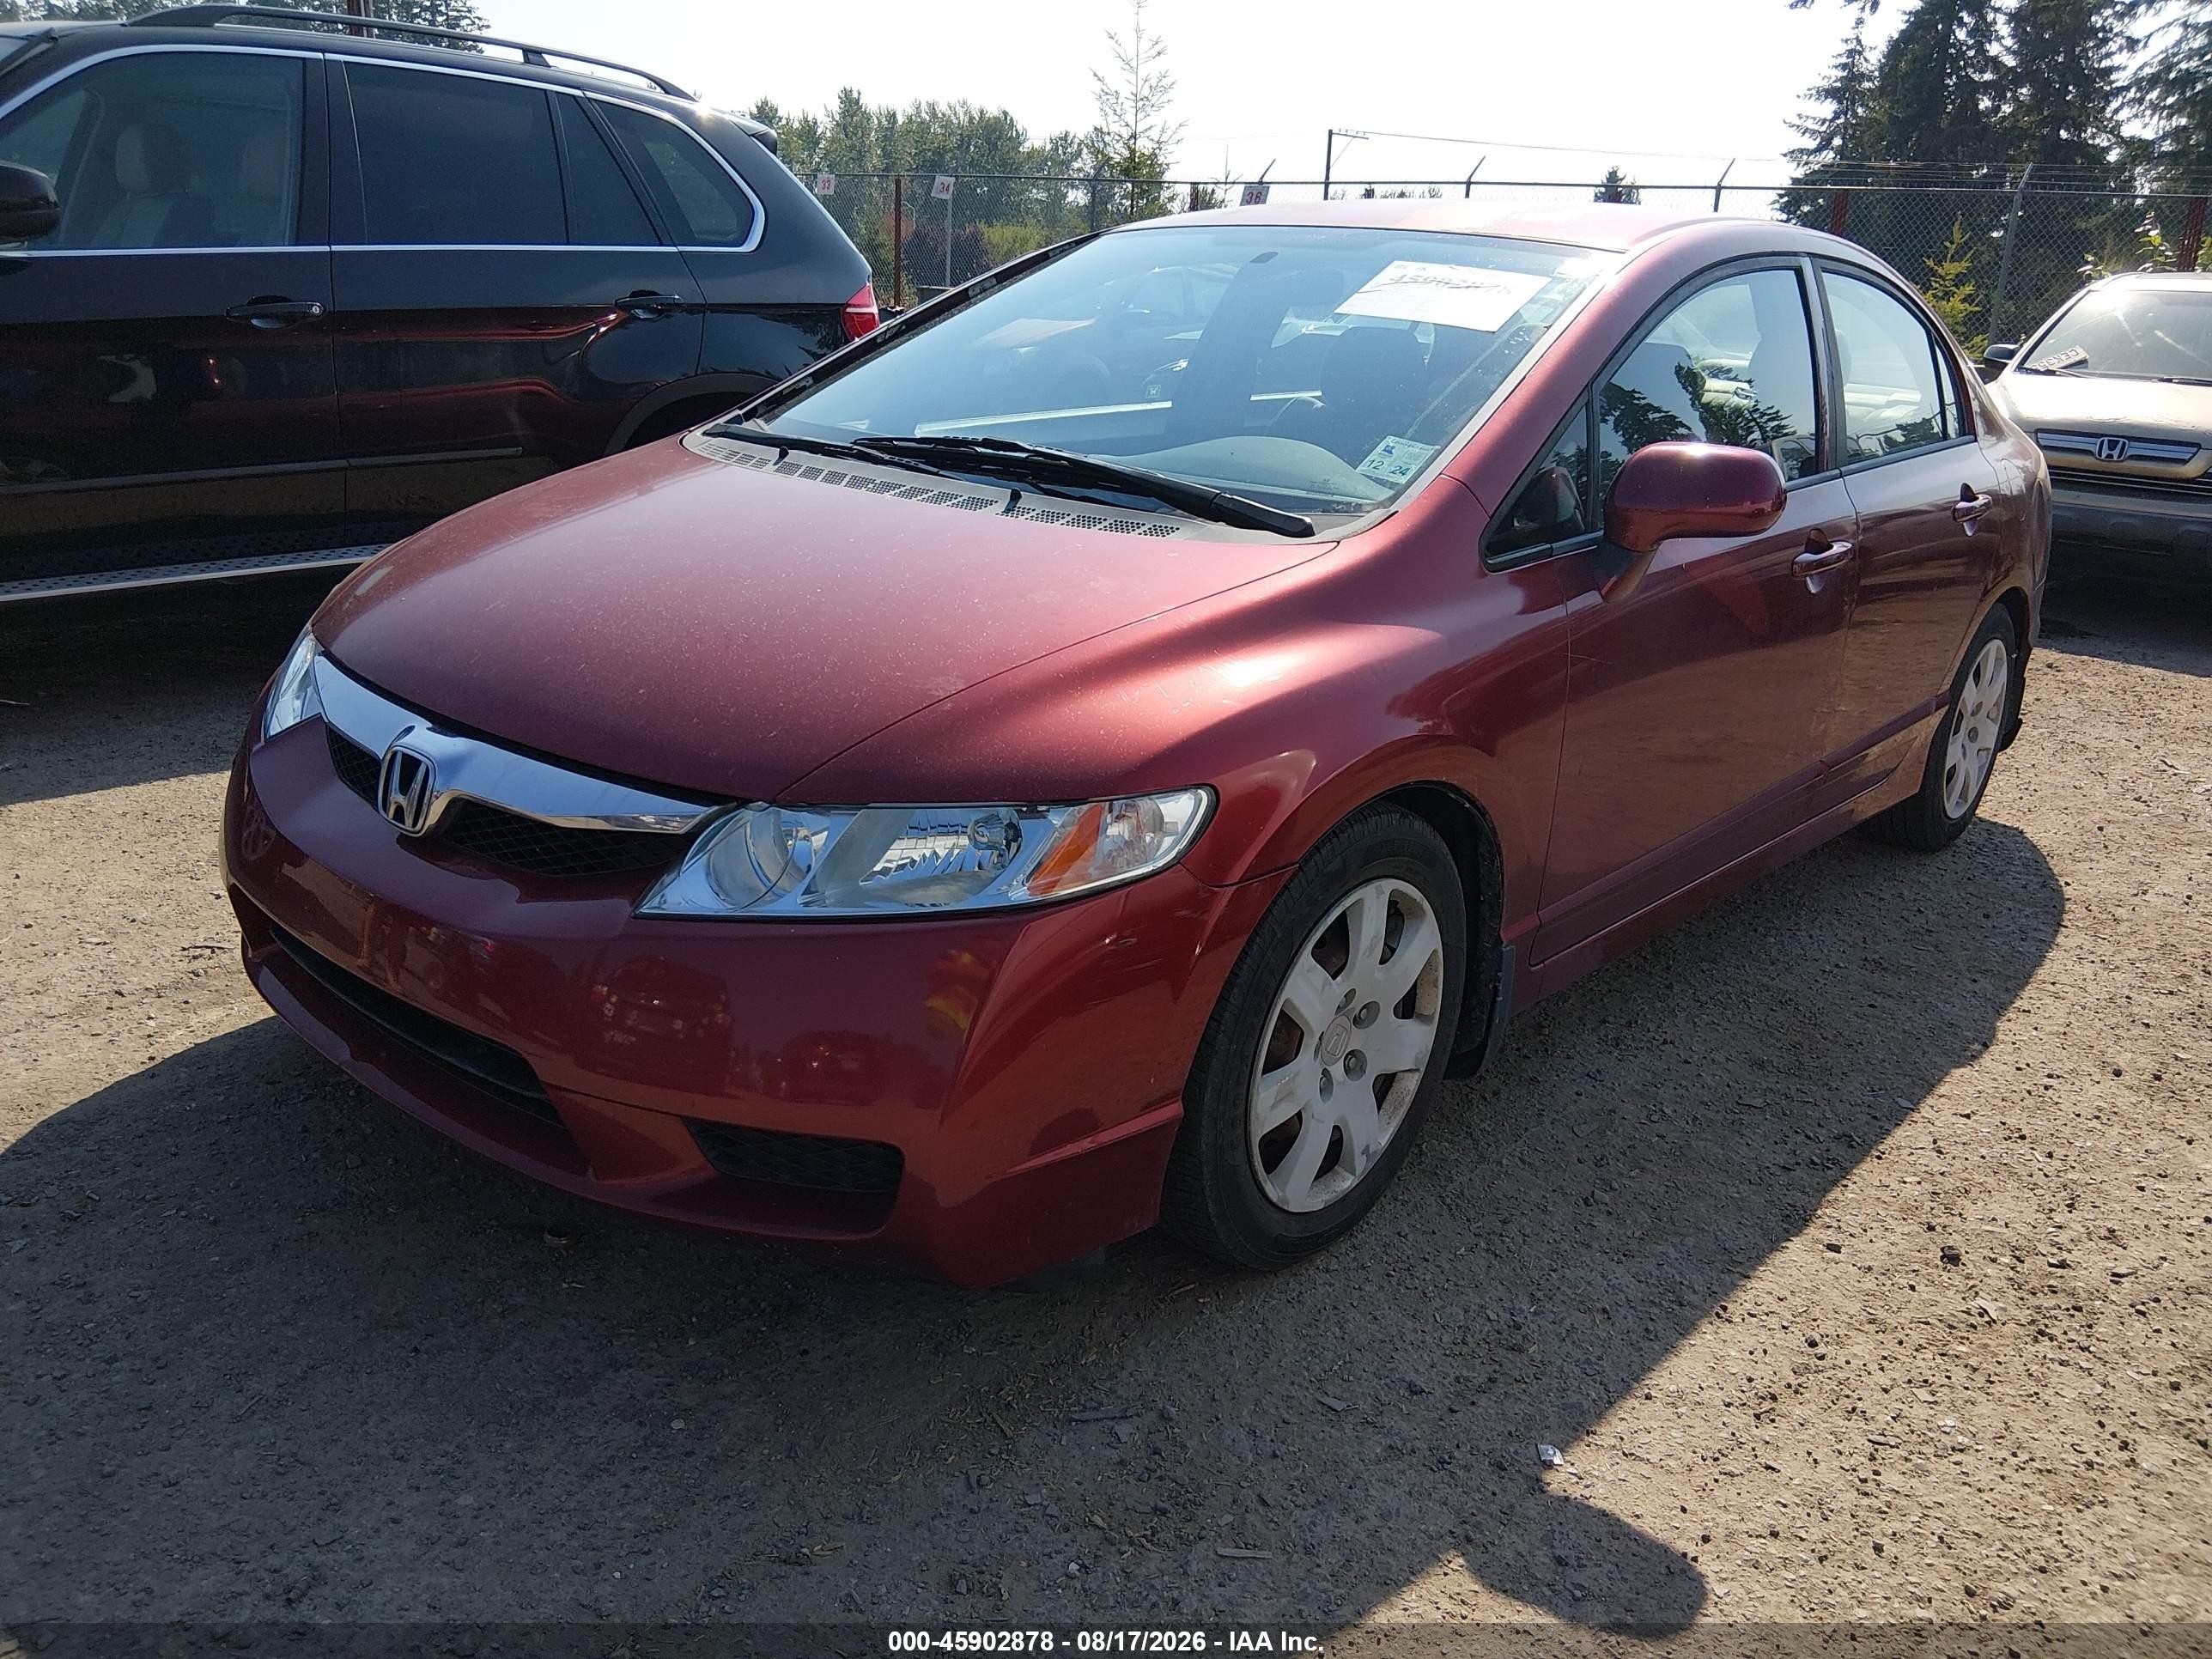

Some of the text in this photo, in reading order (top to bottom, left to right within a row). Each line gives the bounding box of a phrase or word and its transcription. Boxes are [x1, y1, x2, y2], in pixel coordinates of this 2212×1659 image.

[821, 179, 831, 191] 33
[939, 181, 951, 194] 34
[1246, 191, 1262, 204] 36
[1366, 459, 1411, 477] 12 24
